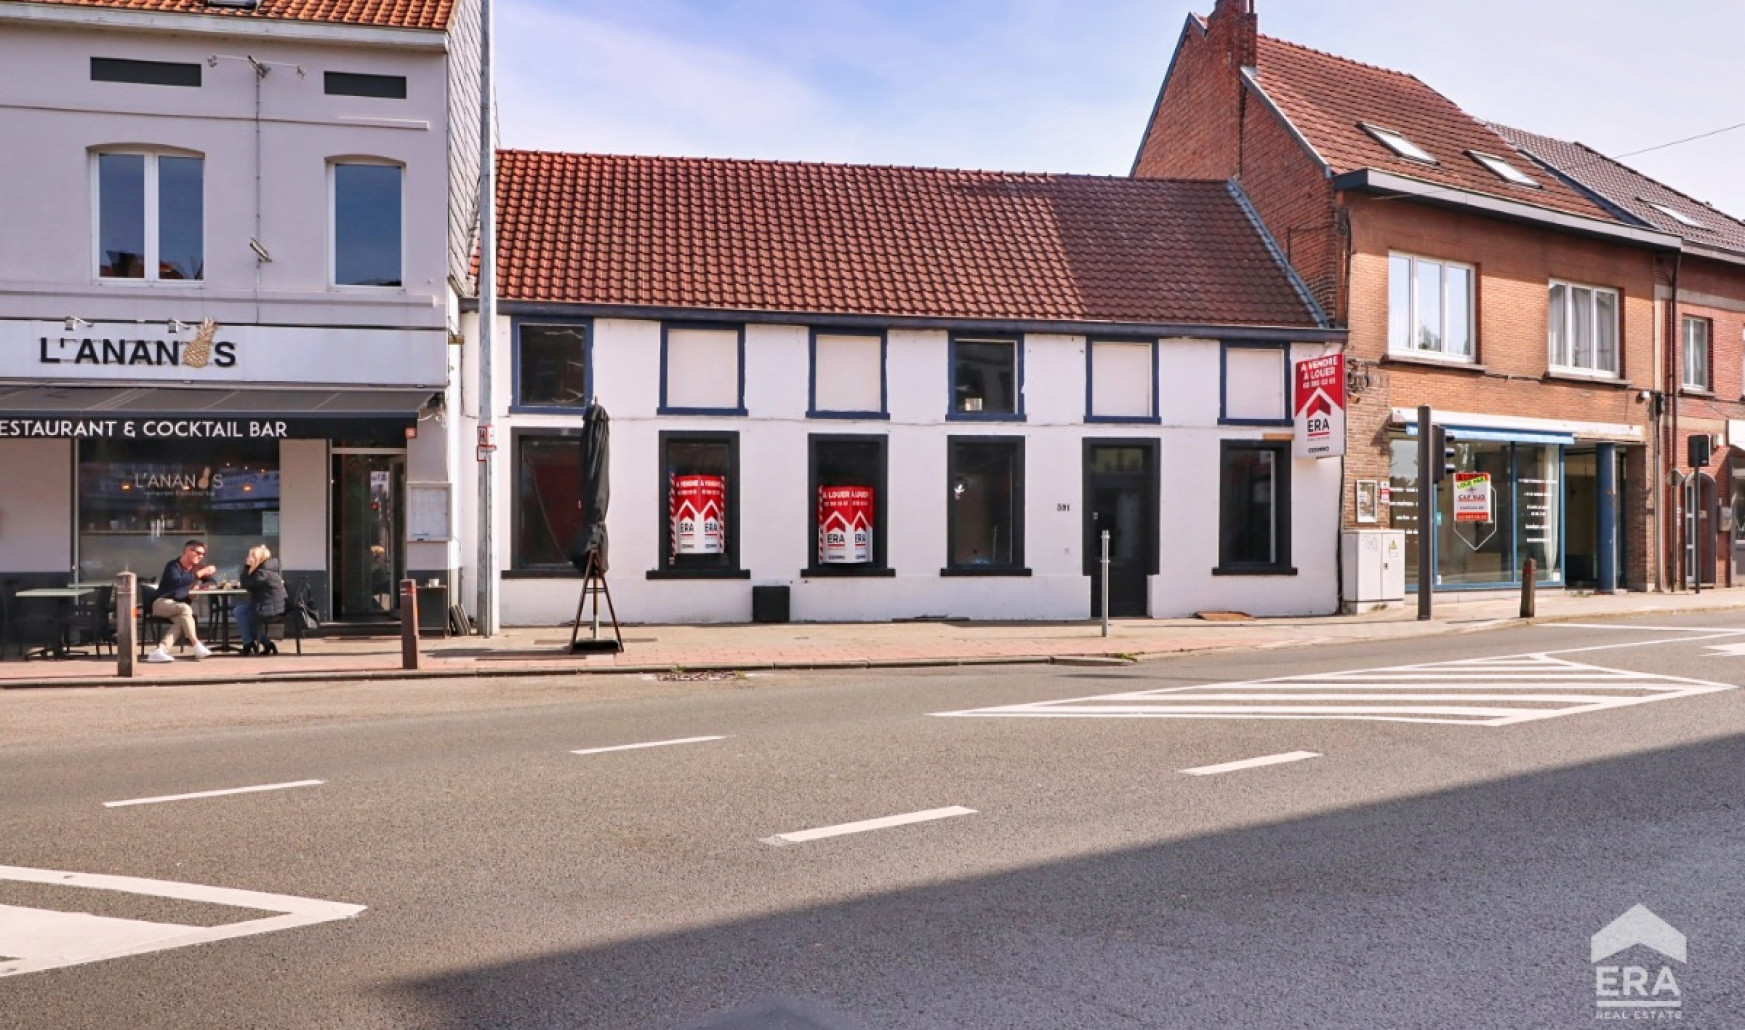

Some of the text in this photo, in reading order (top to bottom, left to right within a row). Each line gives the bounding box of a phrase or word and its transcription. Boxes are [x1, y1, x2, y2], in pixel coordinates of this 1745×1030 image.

[1308, 356, 1338, 370] VENDRE
[1310, 366, 1335, 380] LOUER
[124, 421, 136, 438] &
[143, 420, 243, 438] COCKTAIL
[250, 421, 287, 437] BAR
[1307, 418, 1329, 432] ERA
[680, 523, 694, 533] ERA
[705, 523, 718, 533] ERA
[826, 533, 846, 544] ERA
